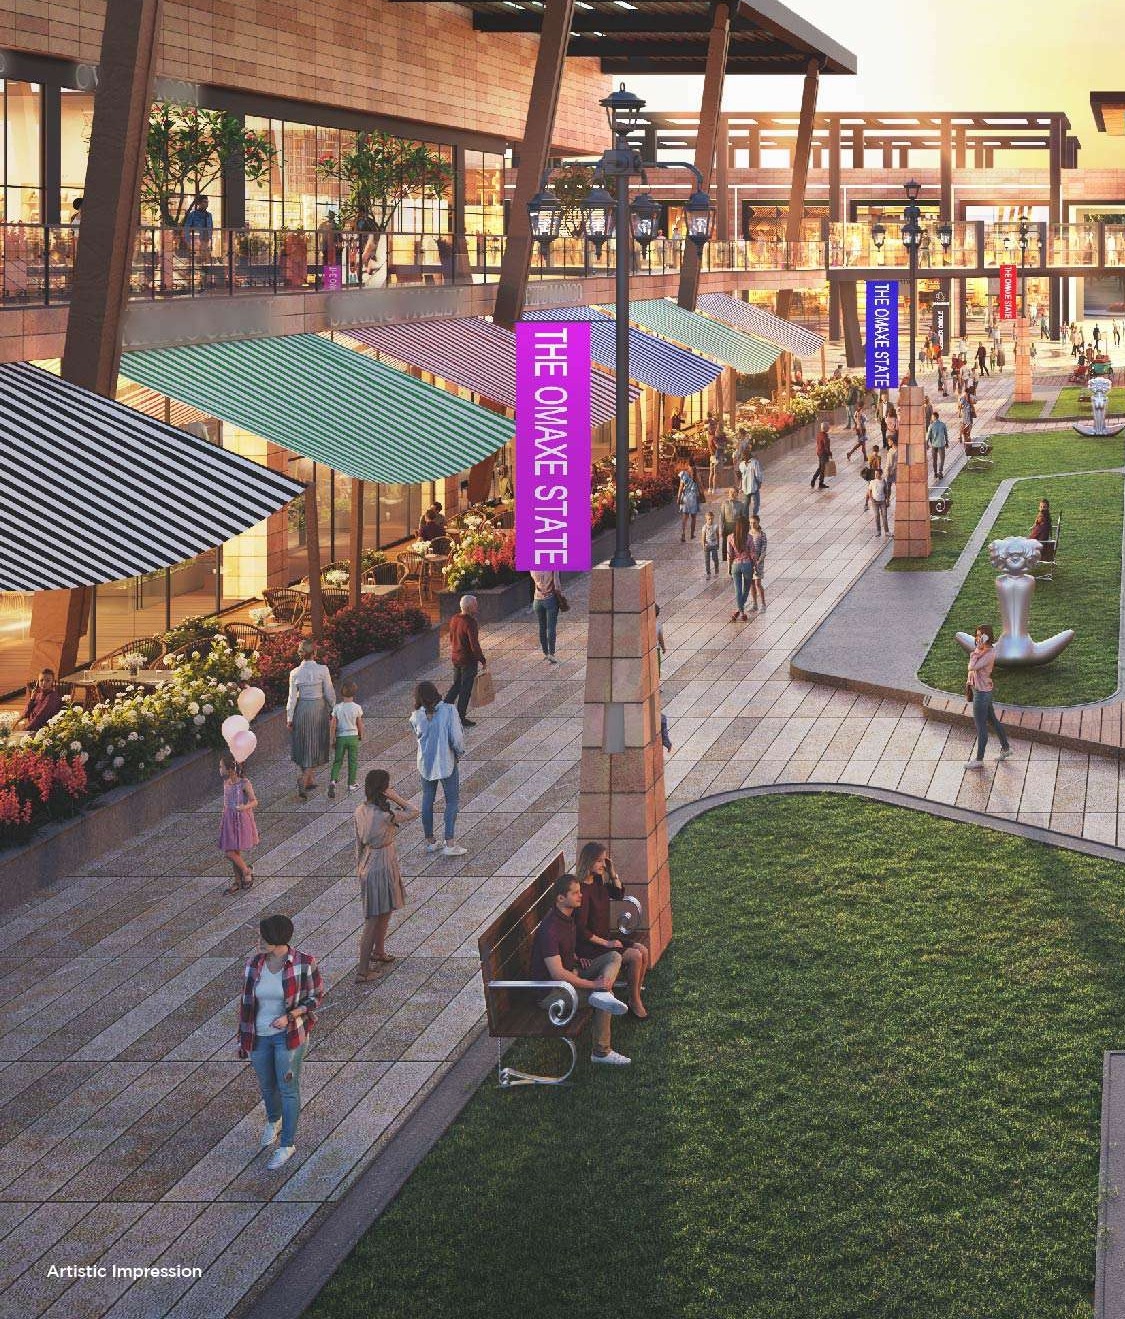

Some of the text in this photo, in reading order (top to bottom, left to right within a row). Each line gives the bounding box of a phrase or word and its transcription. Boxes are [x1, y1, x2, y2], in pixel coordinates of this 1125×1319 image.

[534, 327, 568, 377] THE
[874, 283, 891, 387] THE OMAXE STATE
[534, 386, 568, 476] OMAXE
[534, 485, 568, 565] STATE
